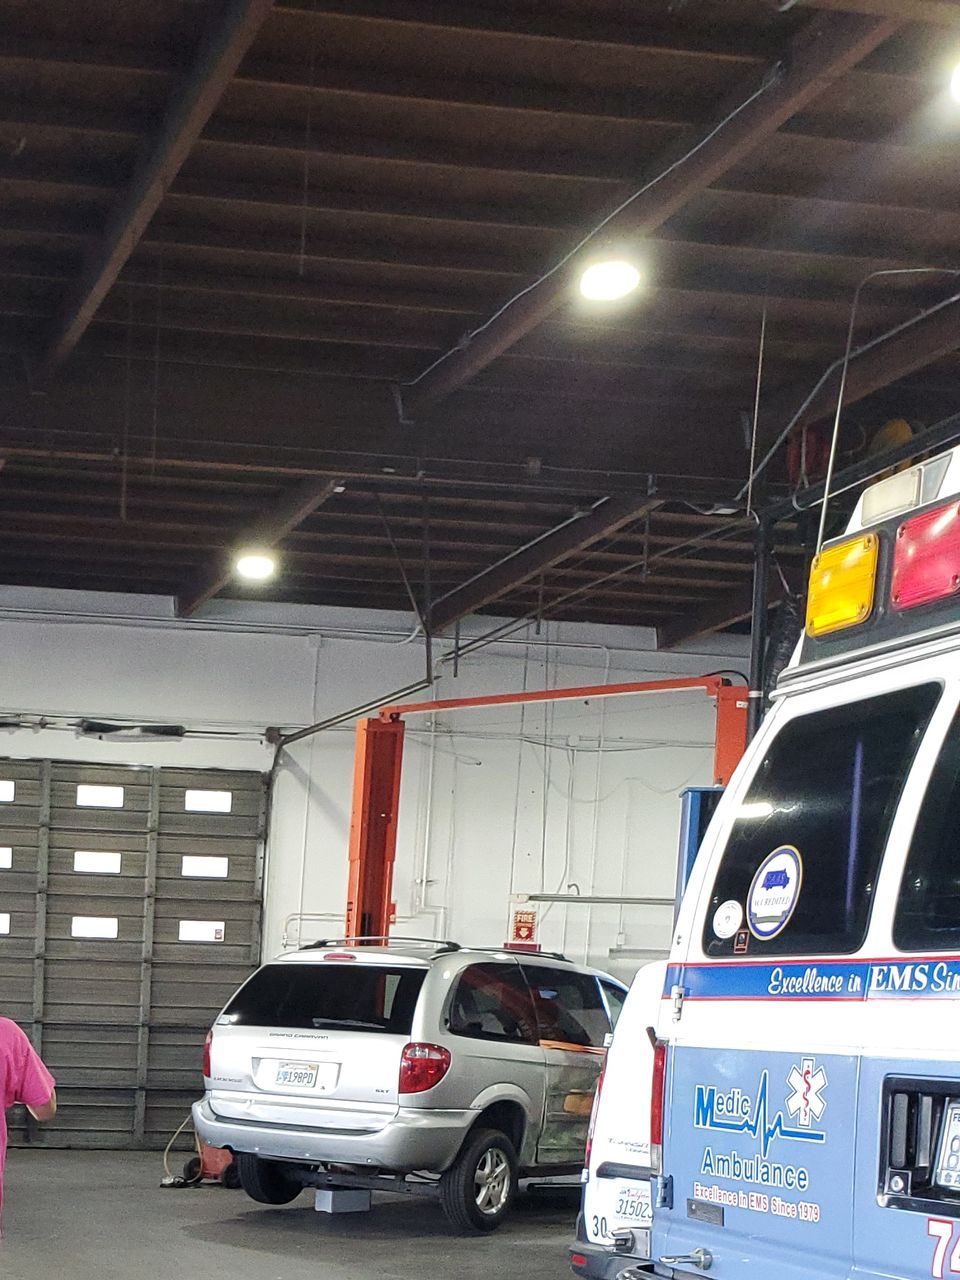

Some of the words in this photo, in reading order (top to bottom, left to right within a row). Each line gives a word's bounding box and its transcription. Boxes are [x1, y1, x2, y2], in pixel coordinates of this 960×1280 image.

[516, 913, 533, 923] FIRE
[767, 967, 843, 995] Excellence
[847, 973, 861, 993] in
[870, 964, 929, 992] EMS
[694, 1085, 751, 1128] Medic
[701, 1147, 809, 1192] Ambulance
[694, 1182, 738, 1204] Excellence
[738, 1190, 748, 1208] in
[749, 1192, 768, 1213] EMS
[771, 1196, 797, 1218] Since
[798, 1201, 820, 1222] 1979
[592, 1215, 607, 1238] 30
